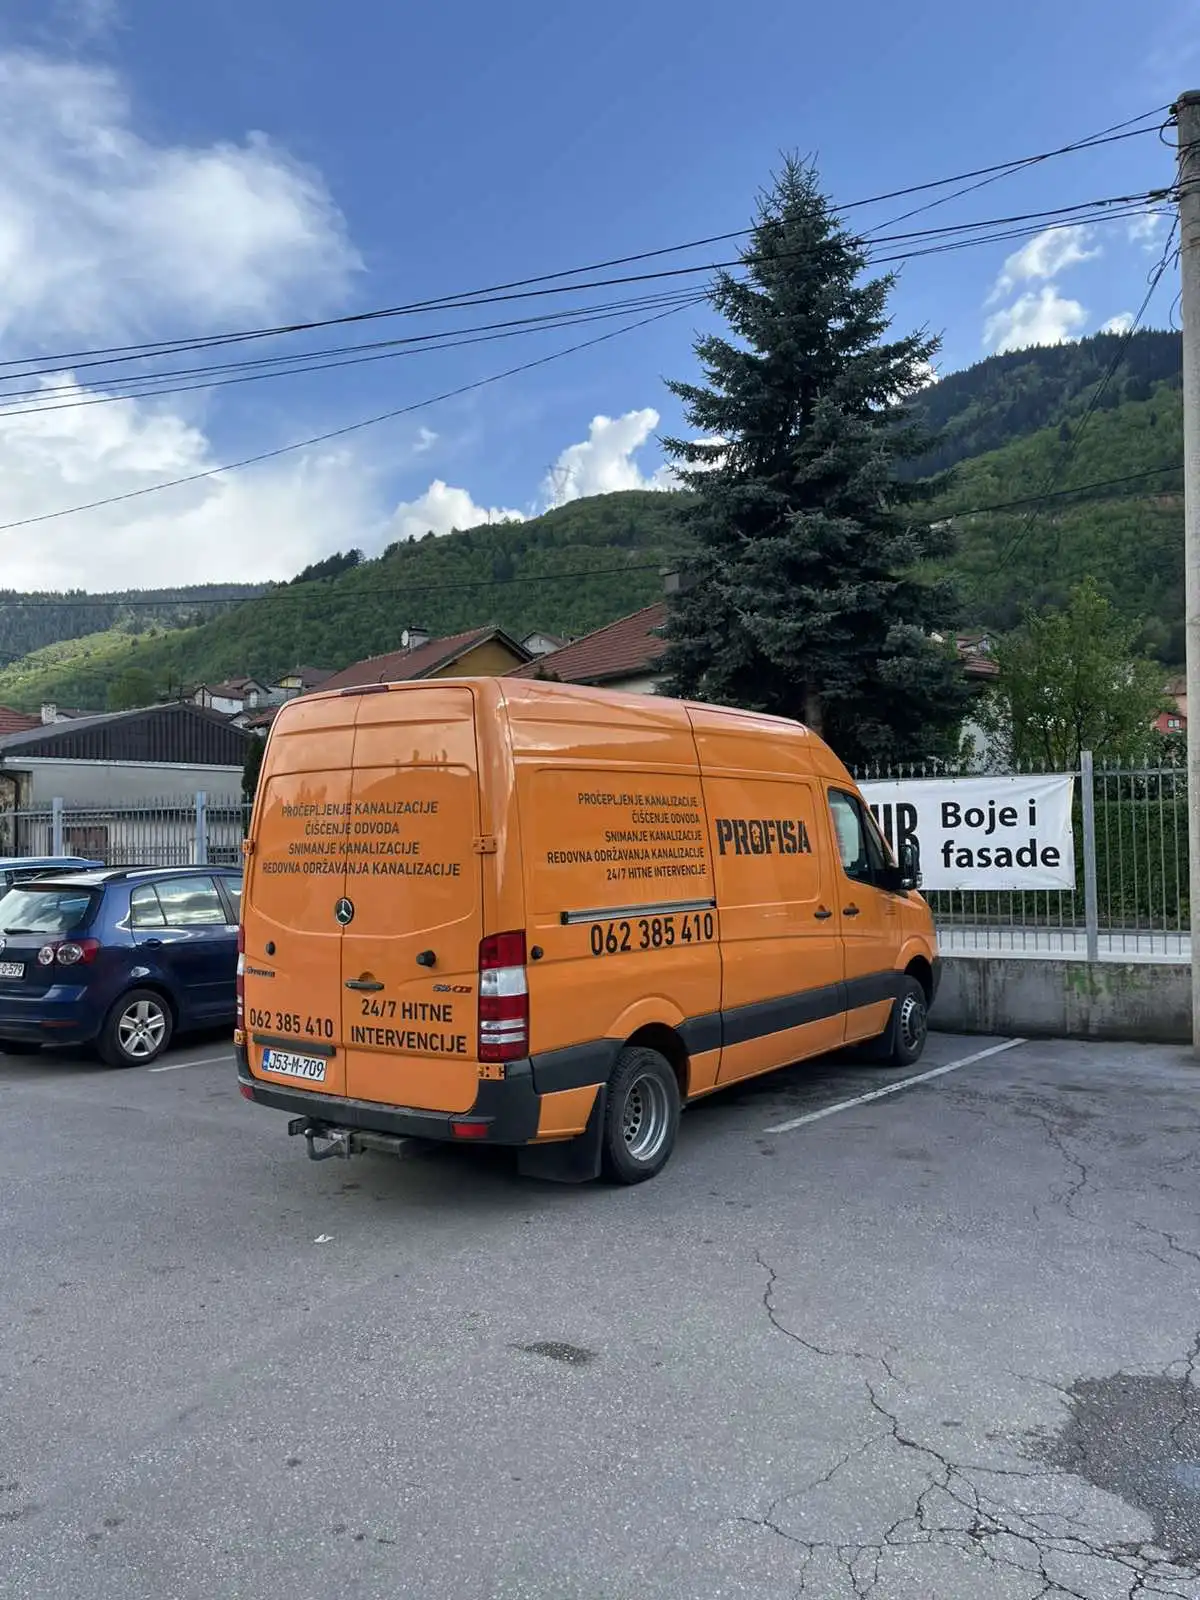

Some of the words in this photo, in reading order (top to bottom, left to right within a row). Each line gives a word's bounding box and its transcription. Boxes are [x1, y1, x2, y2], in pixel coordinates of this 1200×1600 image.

[354, 800, 439, 815] KANALIZACIJE
[645, 795, 699, 808] KANALIZACIJE
[670, 812, 701, 824] ODVODA
[941, 800, 1018, 835] Boje
[1029, 798, 1037, 826] i
[354, 821, 400, 835] ODVODA
[605, 830, 648, 842] SNIMANJE
[649, 830, 703, 841] KANALIZACIJE
[716, 819, 812, 856] PROFISA
[288, 842, 336, 855] SNIMANJE
[339, 842, 419, 855] KANALIZACIJE
[547, 851, 593, 864] REDOVNA
[594, 847, 650, 862] ODRŽAVANJA
[651, 847, 705, 859] KANALIZACIJE
[941, 839, 1060, 868] fasade
[262, 861, 300, 874] REDOVNA
[303, 858, 370, 875] ODRŽAVANJA
[372, 862, 461, 876] KANALIZACIJE
[607, 869, 626, 881] 24/7
[628, 867, 653, 879] HITNE
[654, 864, 707, 877] INTERVENCIJE
[591, 920, 632, 956] 062
[639, 916, 675, 947] 385
[681, 912, 714, 943] 410
[361, 998, 397, 1019] 24/7
[402, 1001, 453, 1023] HITNE
[250, 1008, 272, 1030] 062
[275, 1012, 301, 1034] 385
[305, 1016, 334, 1038] 410
[351, 1026, 467, 1053] INTERVENCIJE
[269, 1053, 325, 1078] J53-M-709
